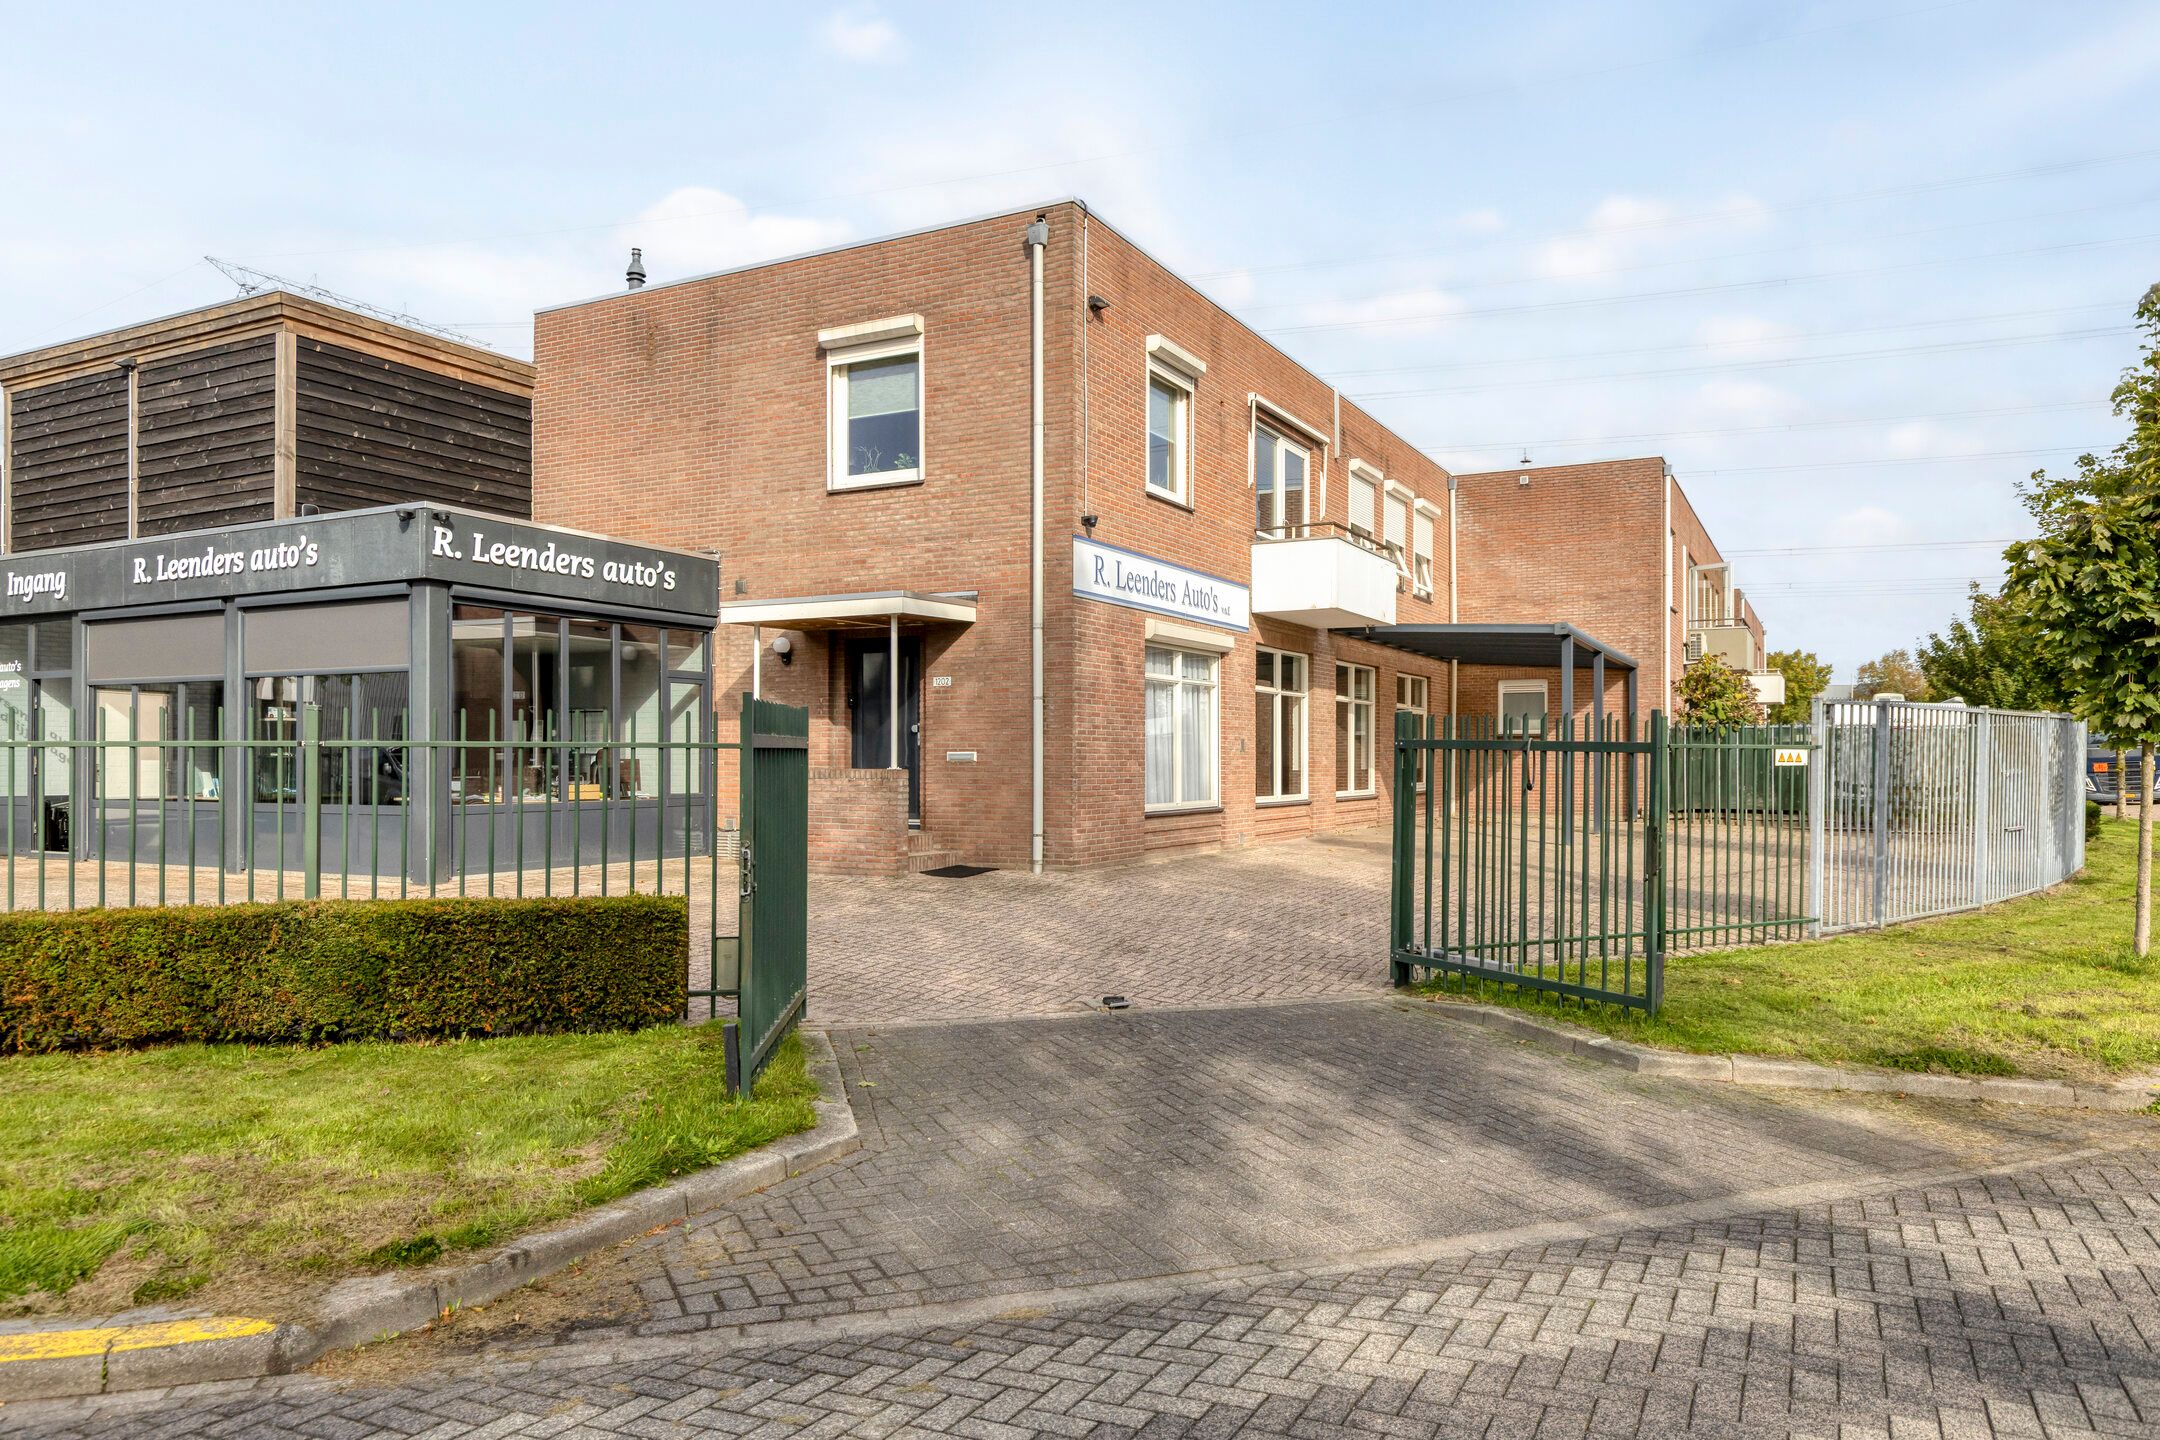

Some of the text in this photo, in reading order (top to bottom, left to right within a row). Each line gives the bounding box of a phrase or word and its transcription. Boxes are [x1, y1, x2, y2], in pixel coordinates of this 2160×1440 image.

[133, 535, 318, 584] R. Leenders auto's
[432, 526, 676, 591] R. Leenders auto's
[7, 572, 66, 603] Ingang
[1094, 555, 1110, 588] R.
[1116, 560, 1176, 603] Leenders
[1182, 580, 1219, 613] Auto's
[935, 677, 950, 686] 1202
